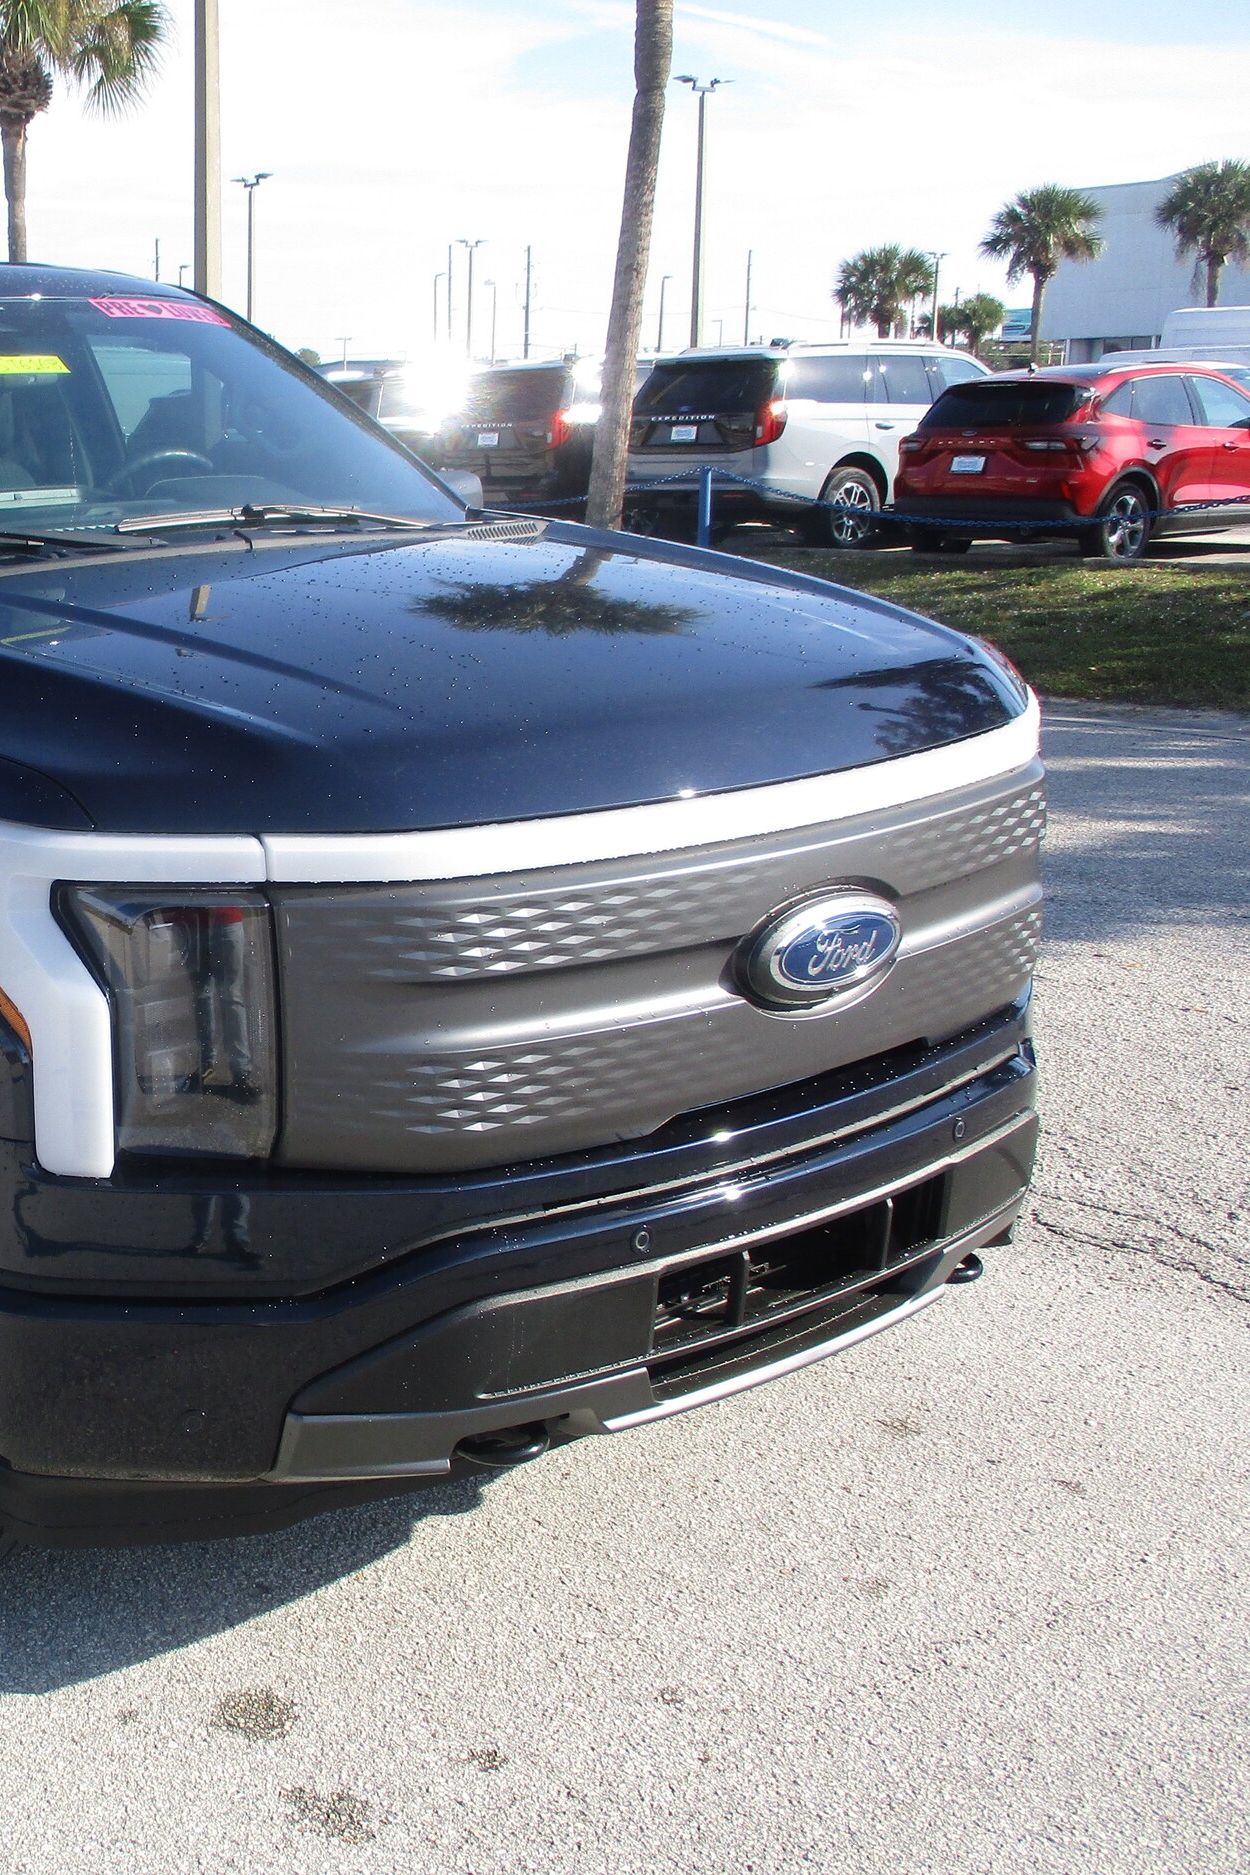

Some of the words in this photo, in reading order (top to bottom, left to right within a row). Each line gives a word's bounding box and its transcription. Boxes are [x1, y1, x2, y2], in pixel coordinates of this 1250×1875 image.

[94, 301, 145, 316] PRE
[651, 414, 716, 422] EXPEDITION
[807, 924, 877, 977] Ford
